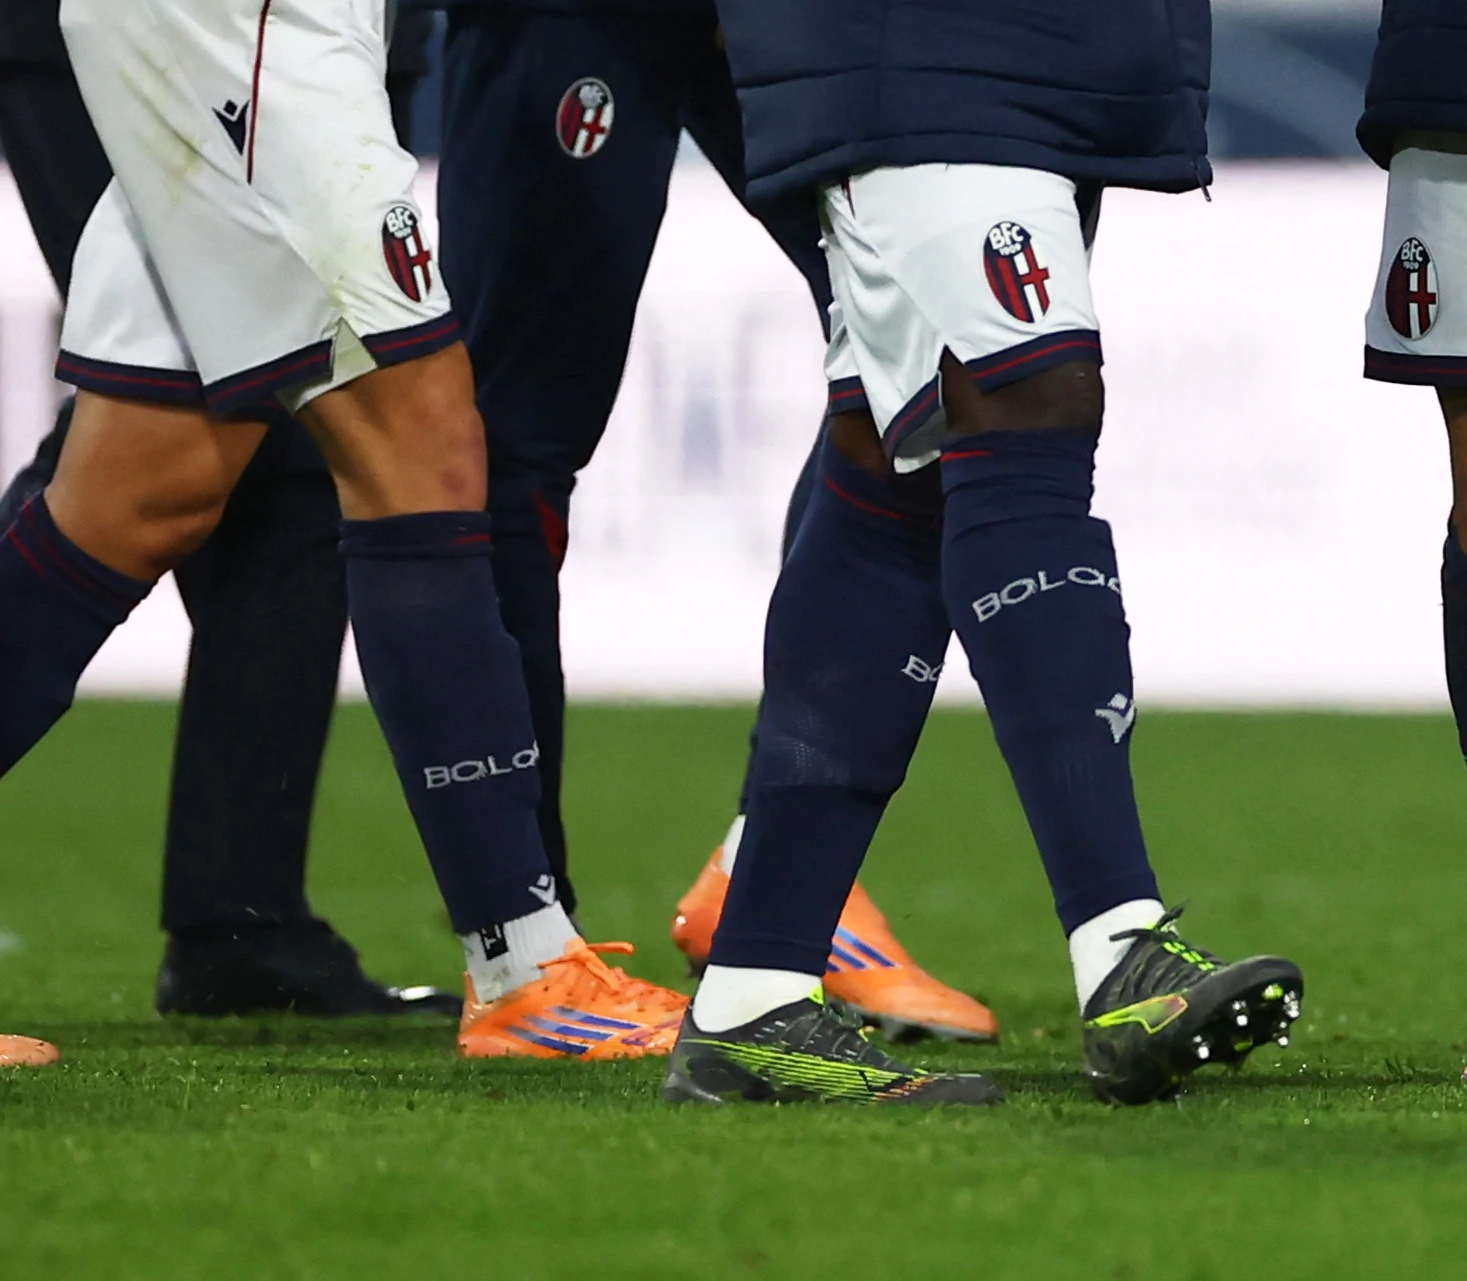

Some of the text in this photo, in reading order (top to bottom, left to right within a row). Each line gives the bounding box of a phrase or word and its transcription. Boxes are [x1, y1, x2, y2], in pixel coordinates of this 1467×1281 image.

[386, 208, 414, 233] BFC
[989, 222, 1024, 250] BFC
[1400, 240, 1424, 262] BFC
